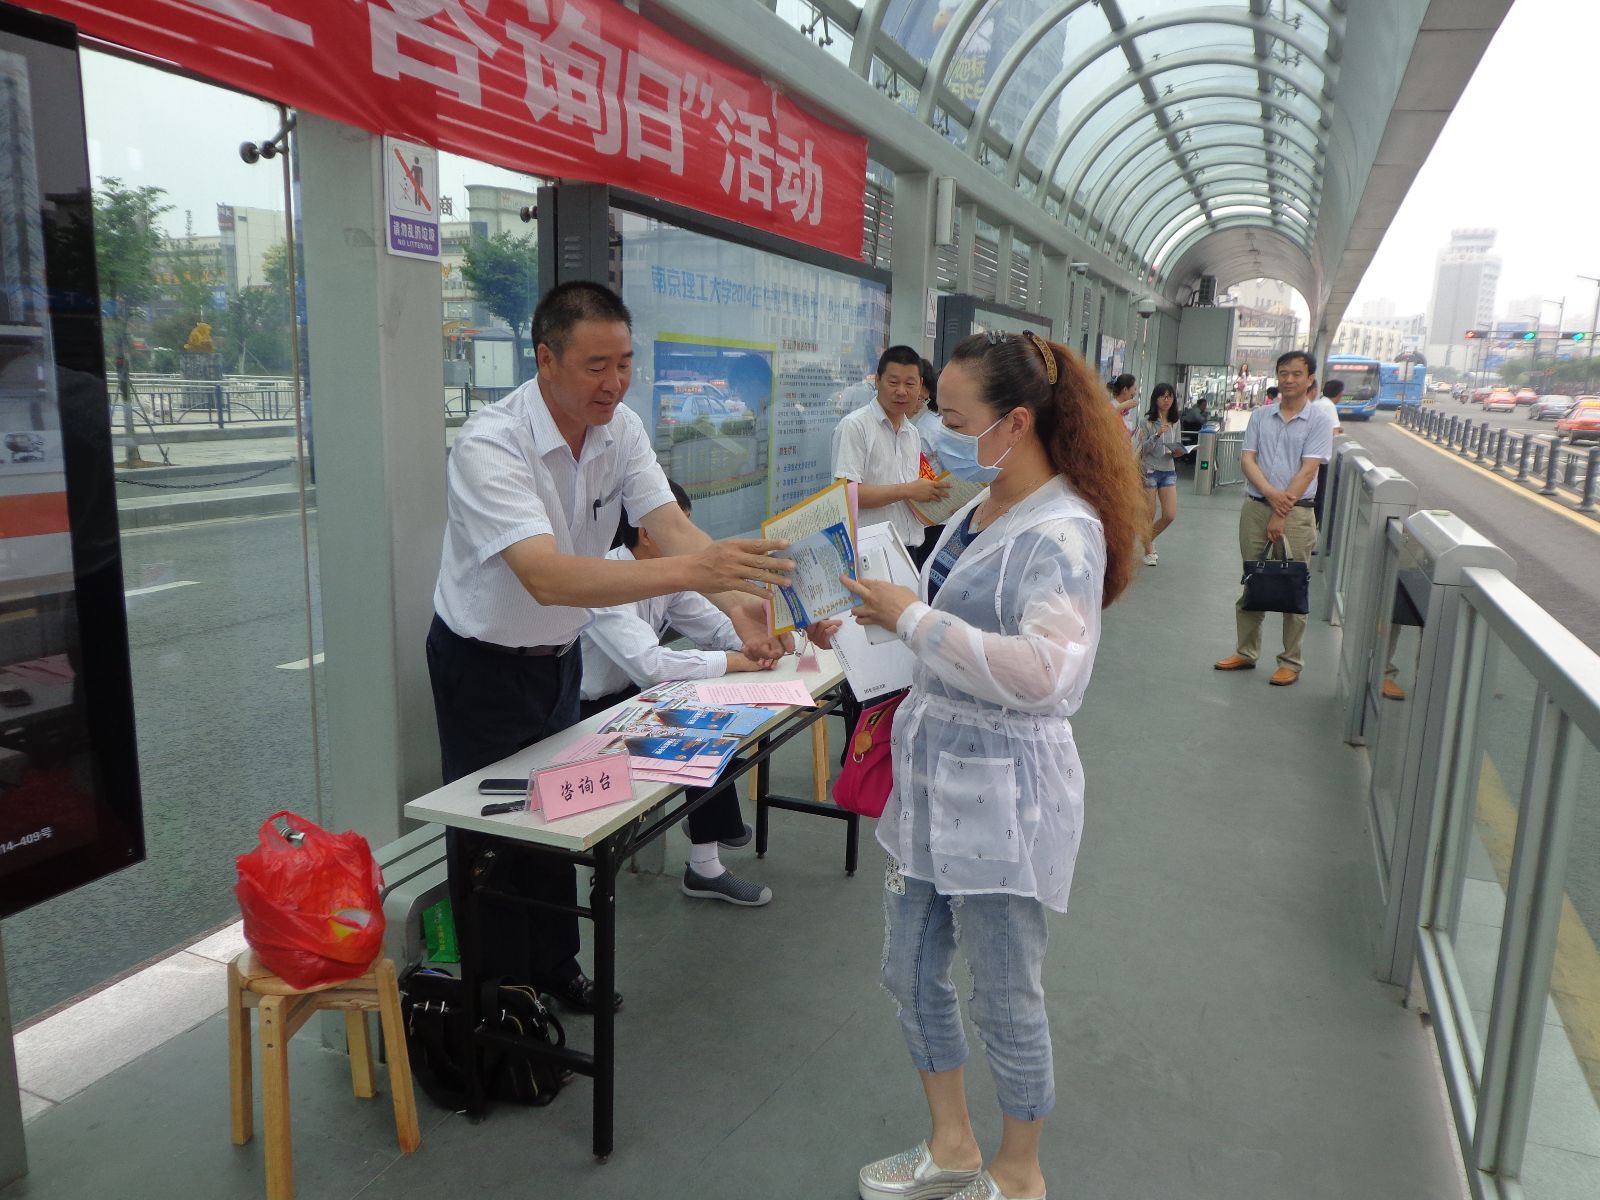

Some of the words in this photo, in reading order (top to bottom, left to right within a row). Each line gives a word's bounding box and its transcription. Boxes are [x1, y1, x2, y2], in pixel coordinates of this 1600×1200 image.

[393, 220, 436, 242] 请勿乱扔垃圾
[397, 238, 406, 246] NO
[407, 240, 433, 251] LITTERING
[560, 771, 611, 802] 咨询台
